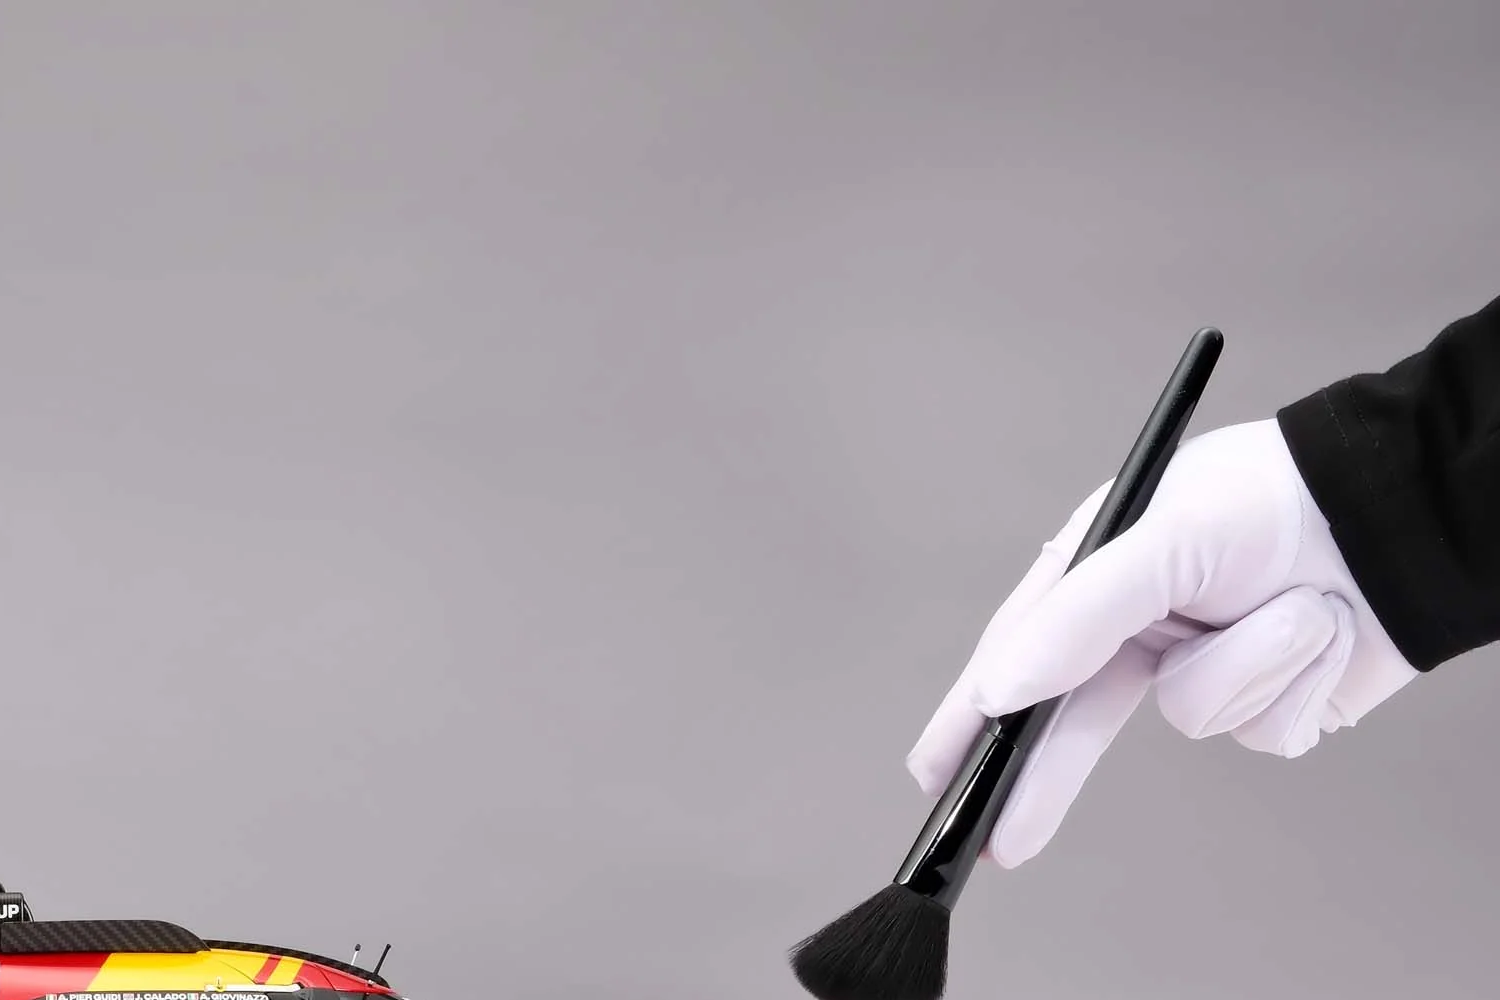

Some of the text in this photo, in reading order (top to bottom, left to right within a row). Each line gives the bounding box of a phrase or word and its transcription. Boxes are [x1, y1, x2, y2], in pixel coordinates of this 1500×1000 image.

[69, 993, 93, 1000] PIER
[93, 993, 120, 1000] GUIDI
[144, 993, 186, 1000] CALADO
